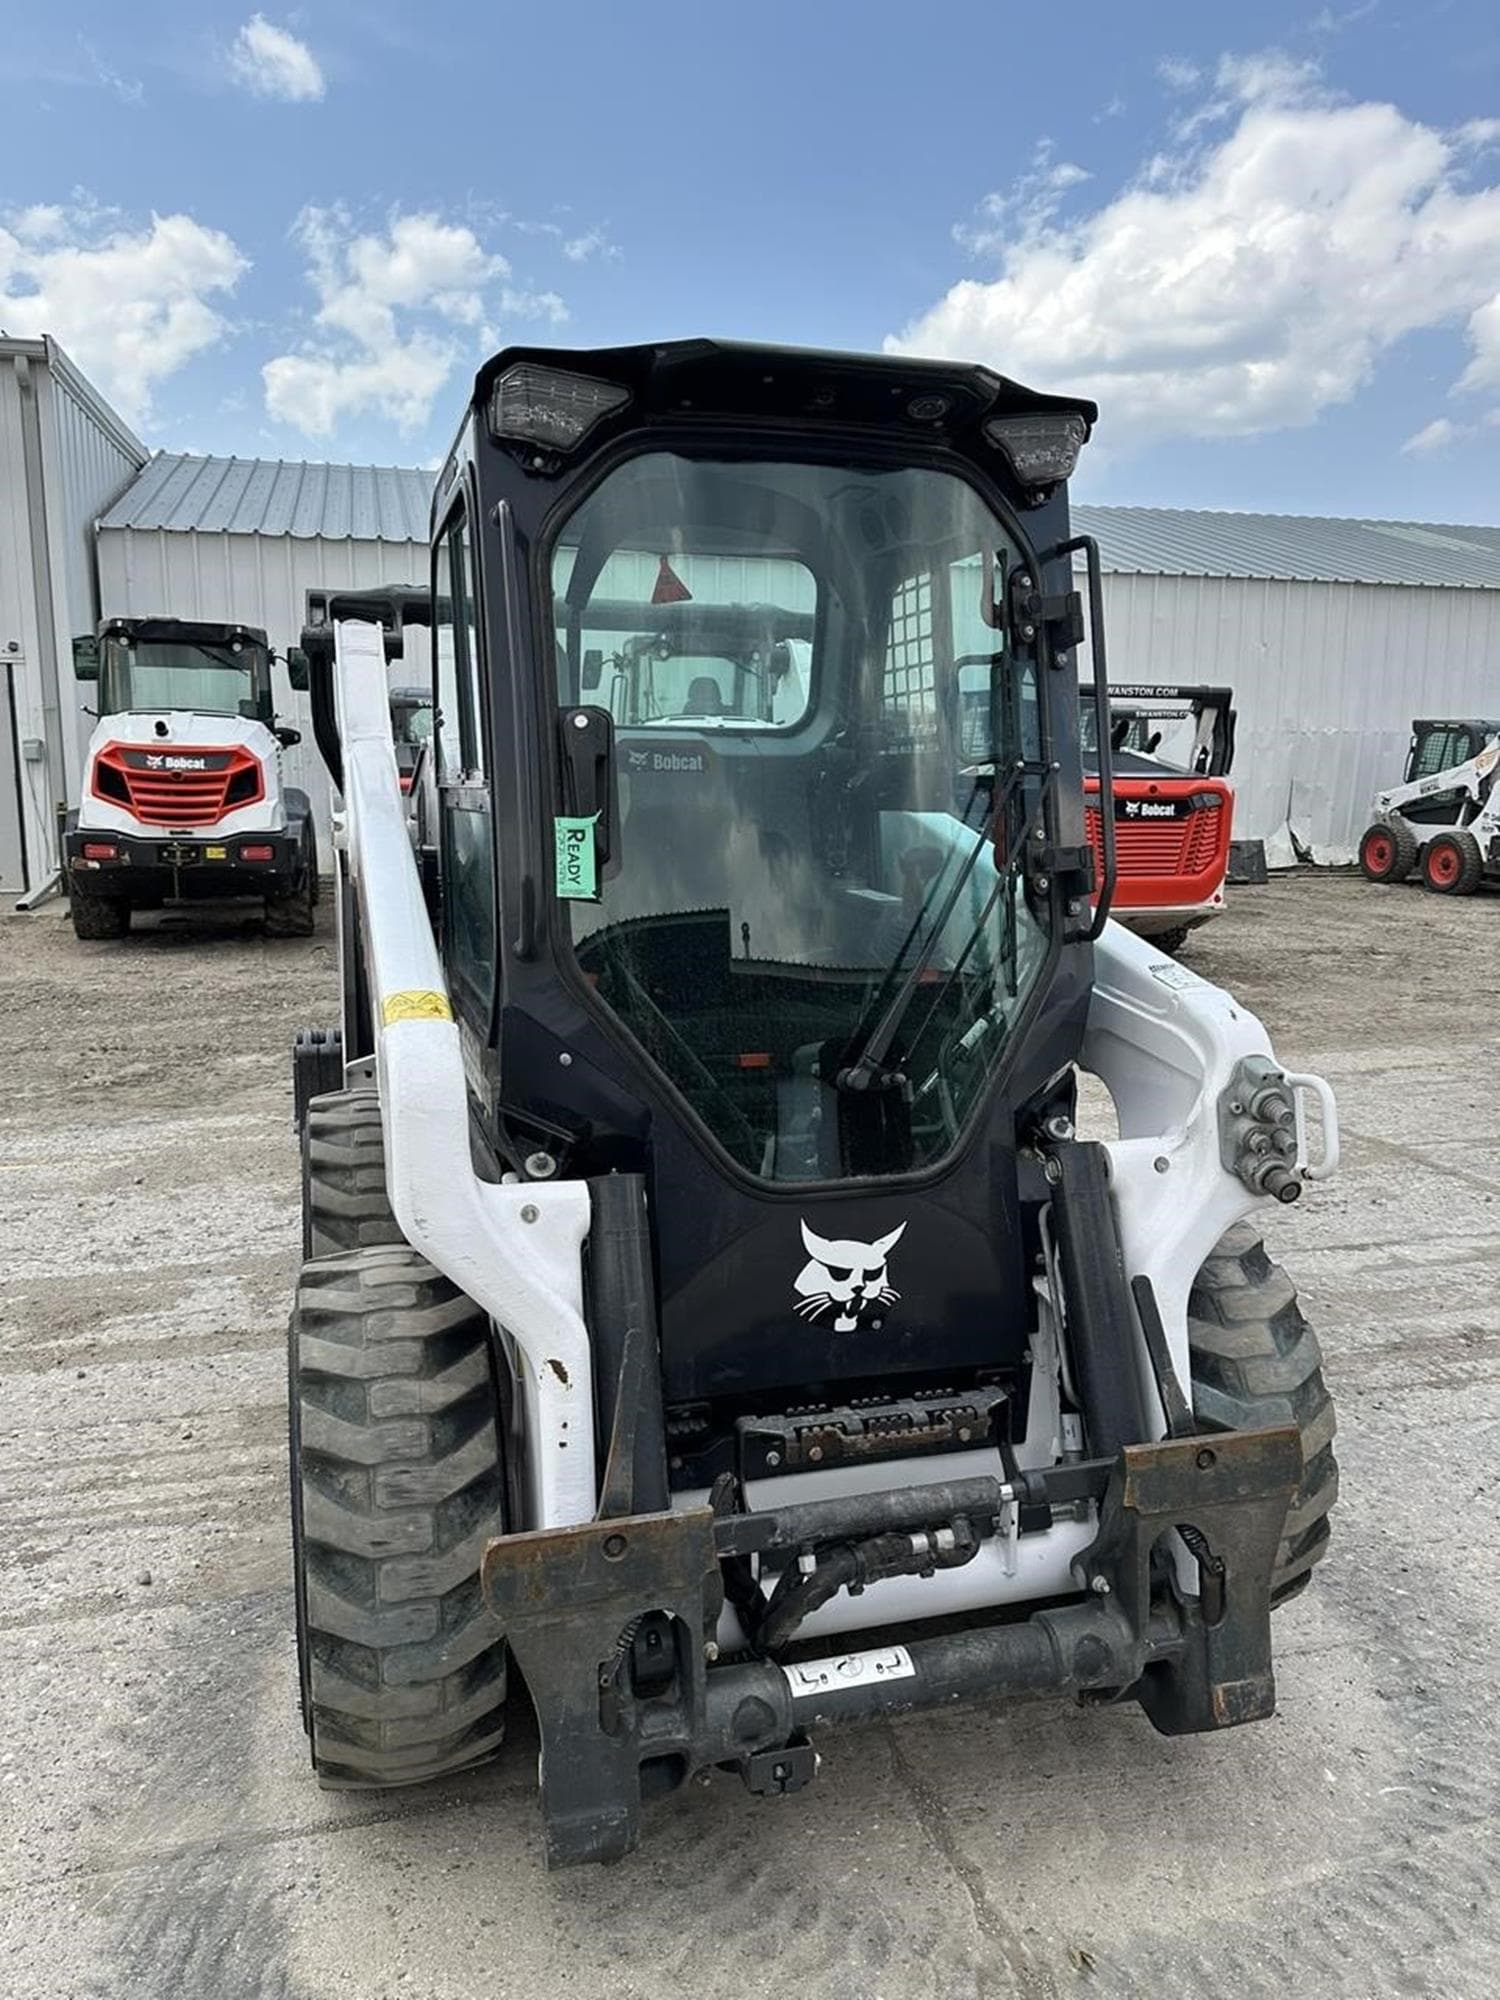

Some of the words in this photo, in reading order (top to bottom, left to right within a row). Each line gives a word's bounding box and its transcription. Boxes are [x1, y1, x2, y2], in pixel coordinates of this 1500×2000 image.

[1106, 687, 1179, 696] WANSTON.COM
[165, 757, 205, 769] Bobcat
[653, 753, 703, 770] Bobcat
[1141, 803, 1175, 816] Bobcat
